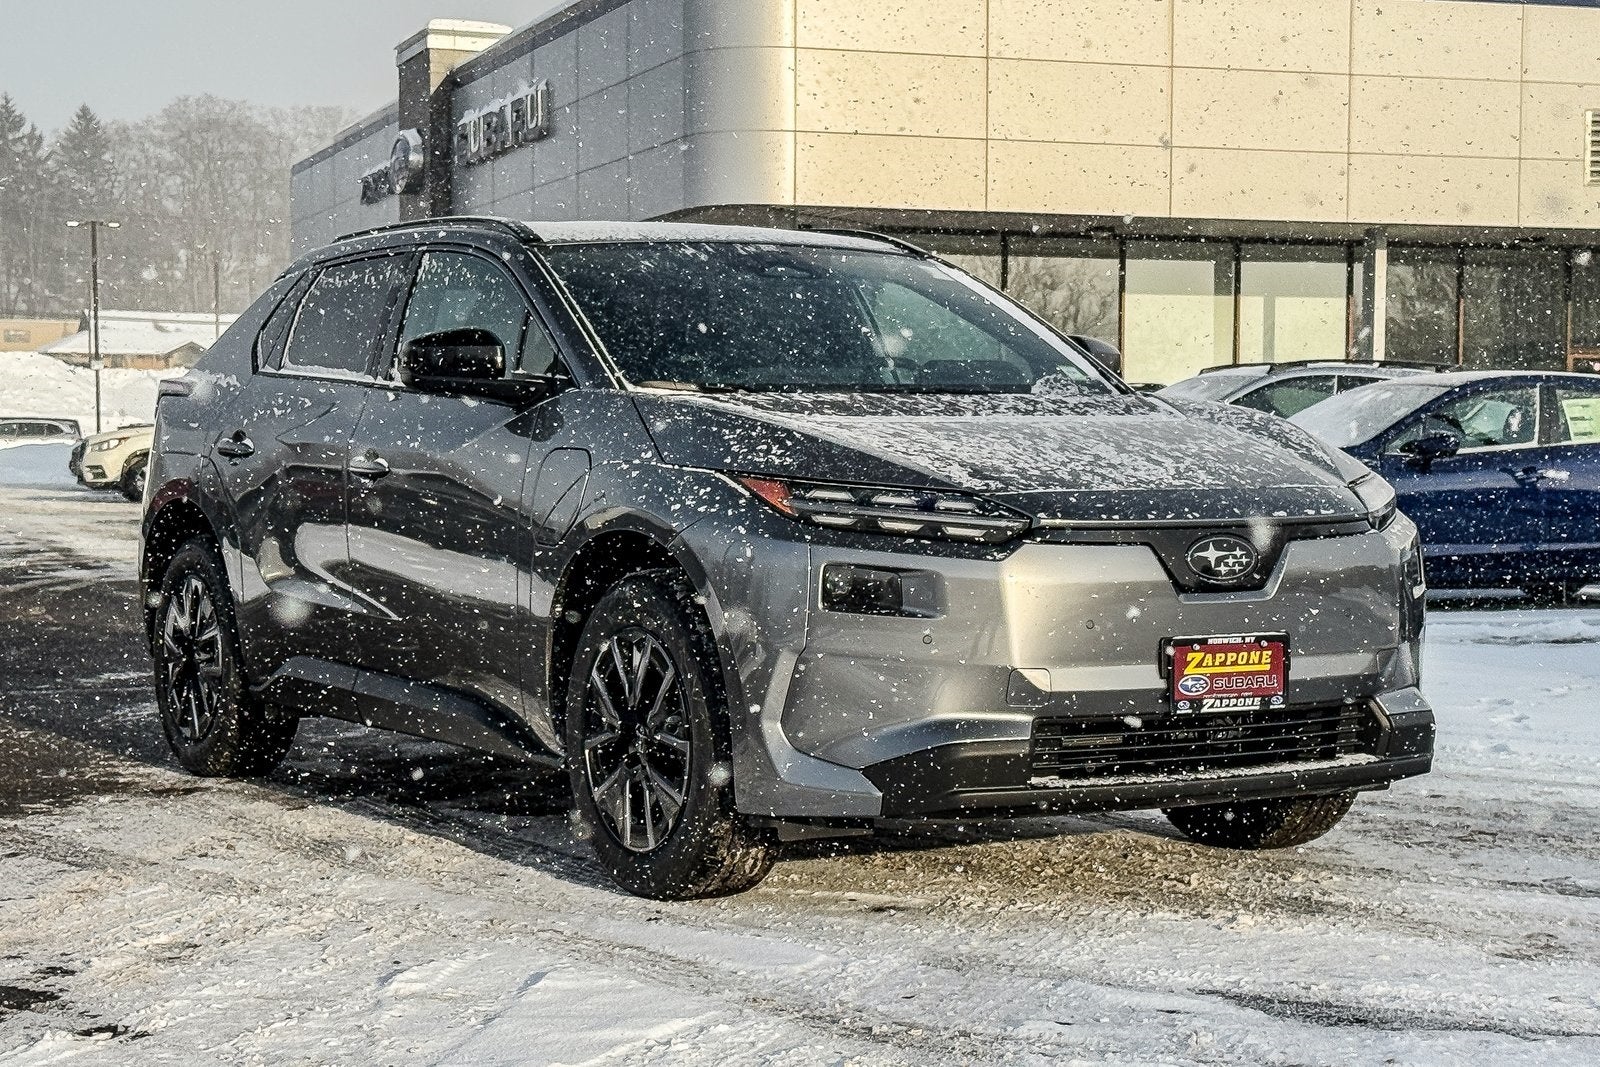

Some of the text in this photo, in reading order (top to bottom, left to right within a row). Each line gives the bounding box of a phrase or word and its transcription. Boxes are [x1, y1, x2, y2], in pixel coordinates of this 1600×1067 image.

[1184, 650, 1272, 675] ZAPPONE
[1214, 675, 1277, 690] SUBARU
[1201, 698, 1261, 713] ZAPPONE
